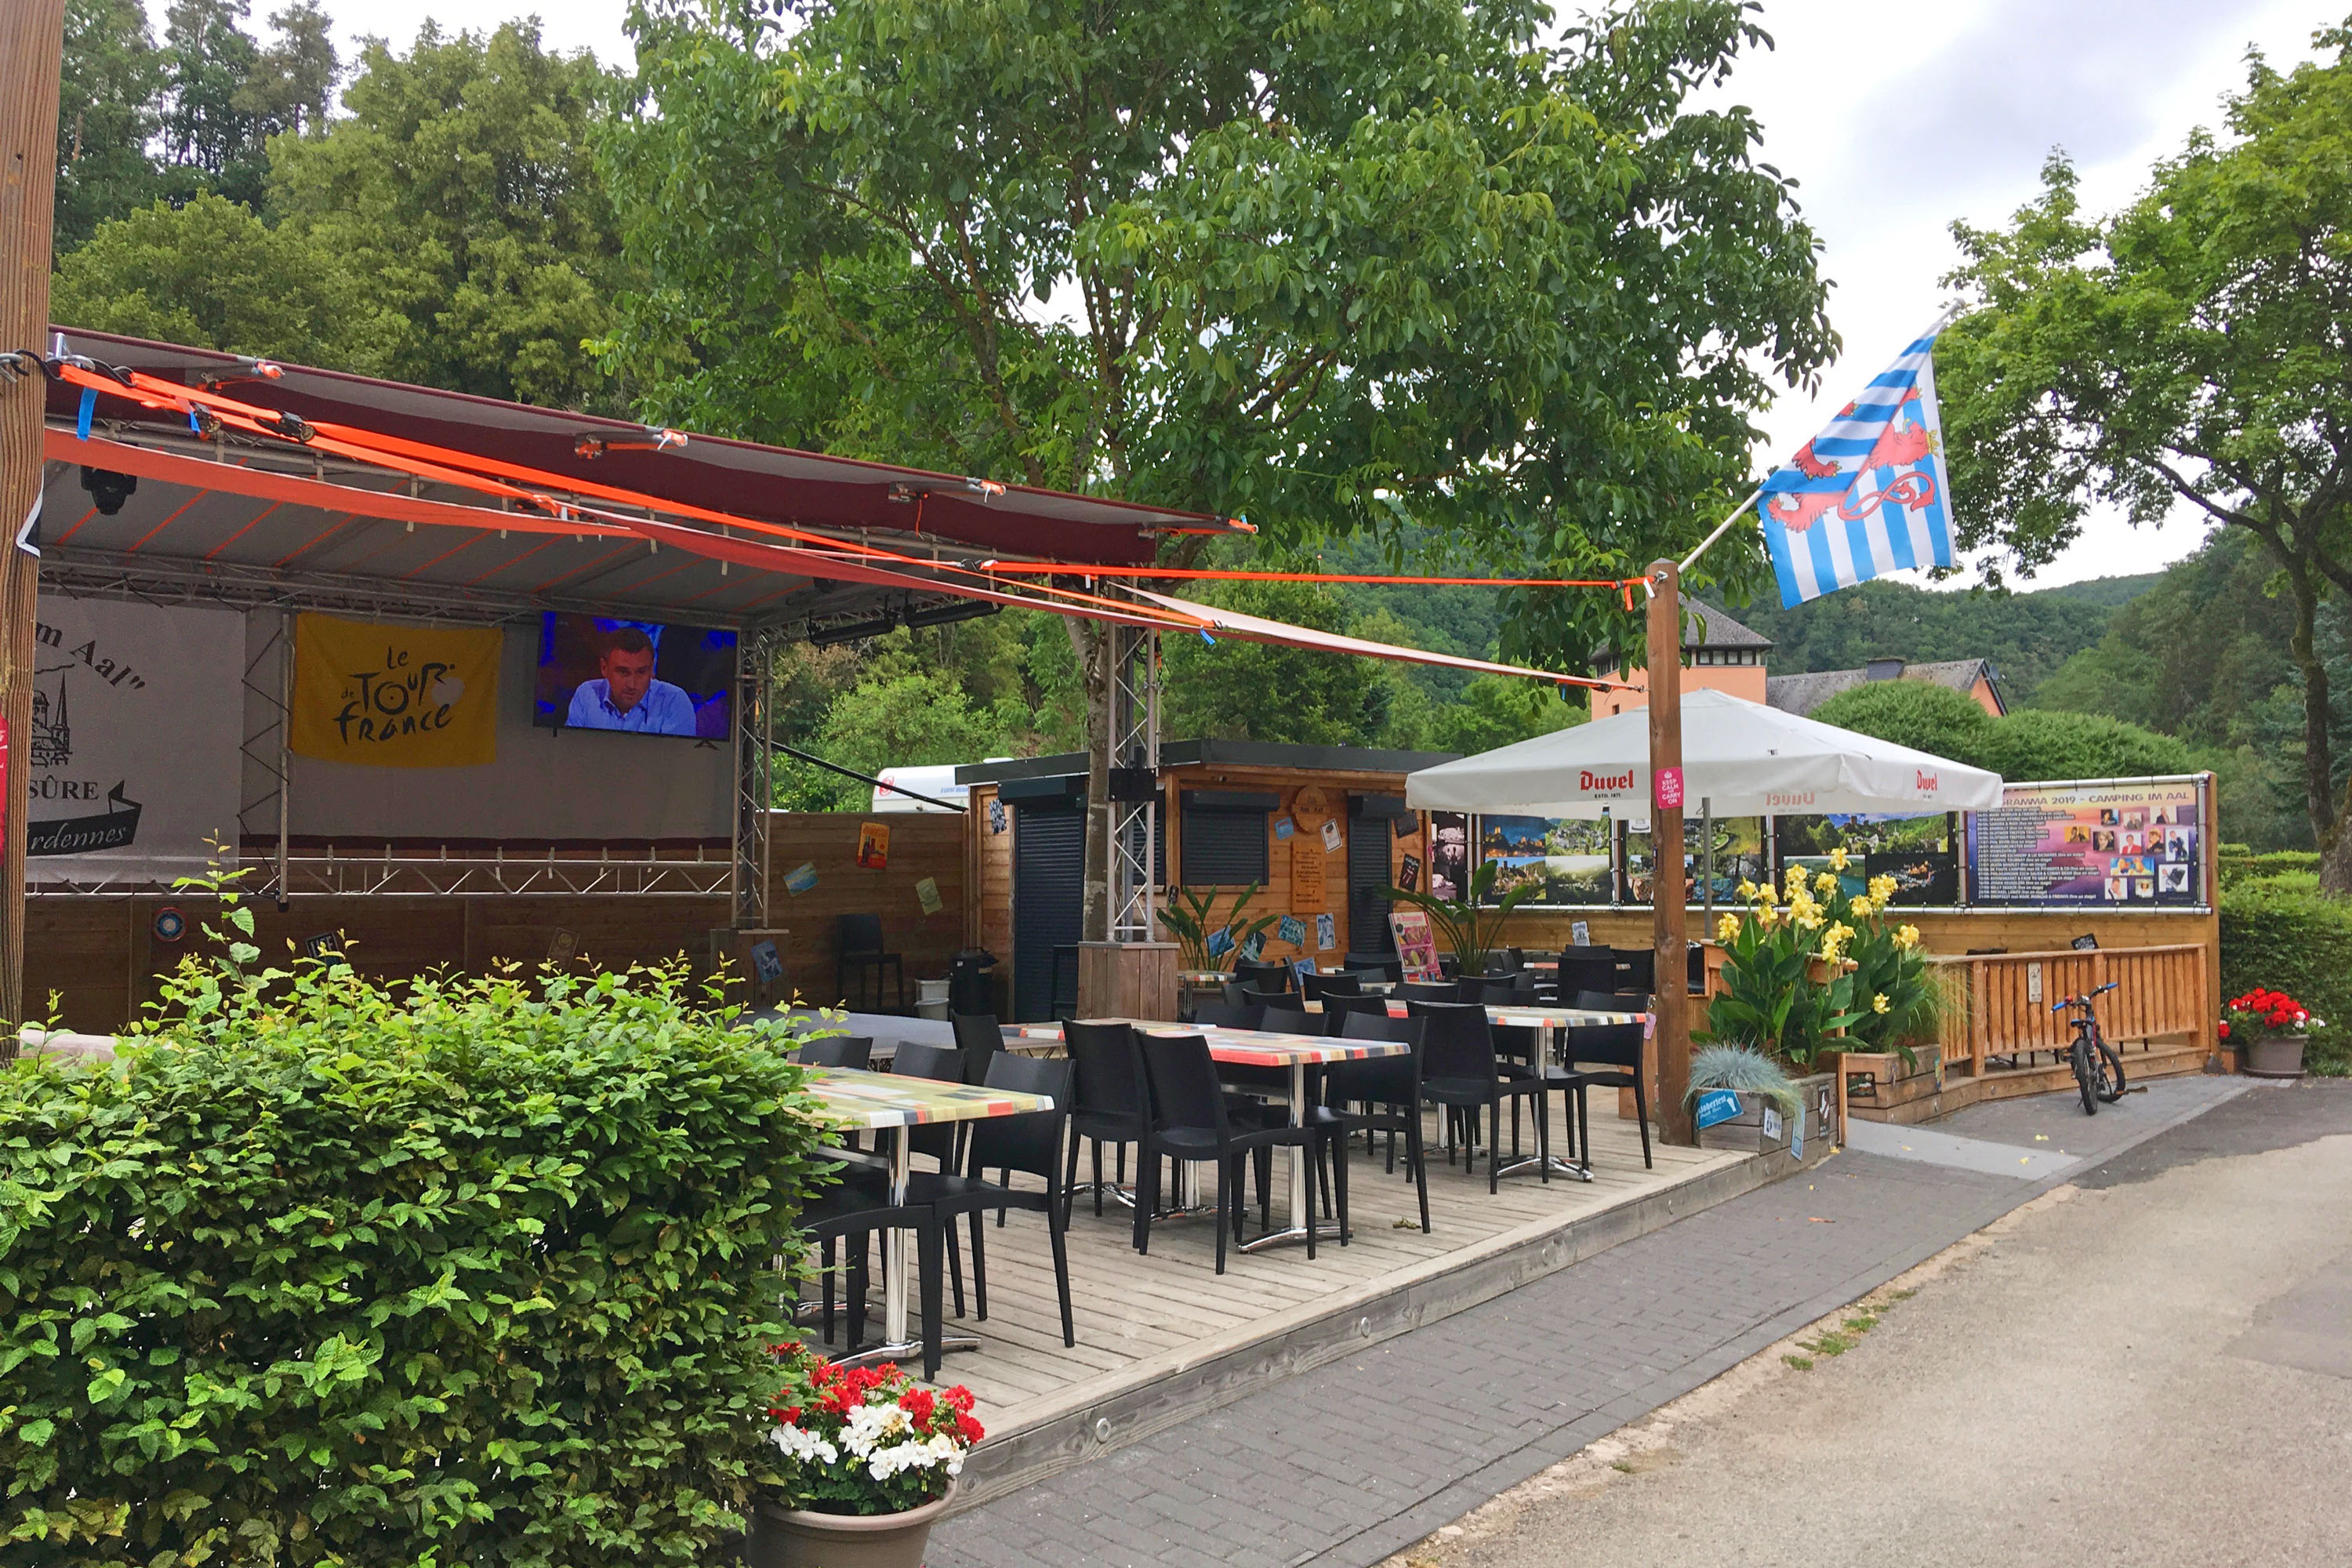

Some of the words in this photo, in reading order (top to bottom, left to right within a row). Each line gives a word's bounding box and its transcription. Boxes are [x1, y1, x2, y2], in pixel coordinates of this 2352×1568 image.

[35, 622, 63, 648] m
[341, 687, 354, 699] de
[1581, 768, 1634, 791] Duvel
[1916, 769, 1938, 791] Duvel
[2052, 796, 2076, 804] 2019
[2089, 793, 2143, 803] CAMPING
[27, 823, 126, 850] rdennes
